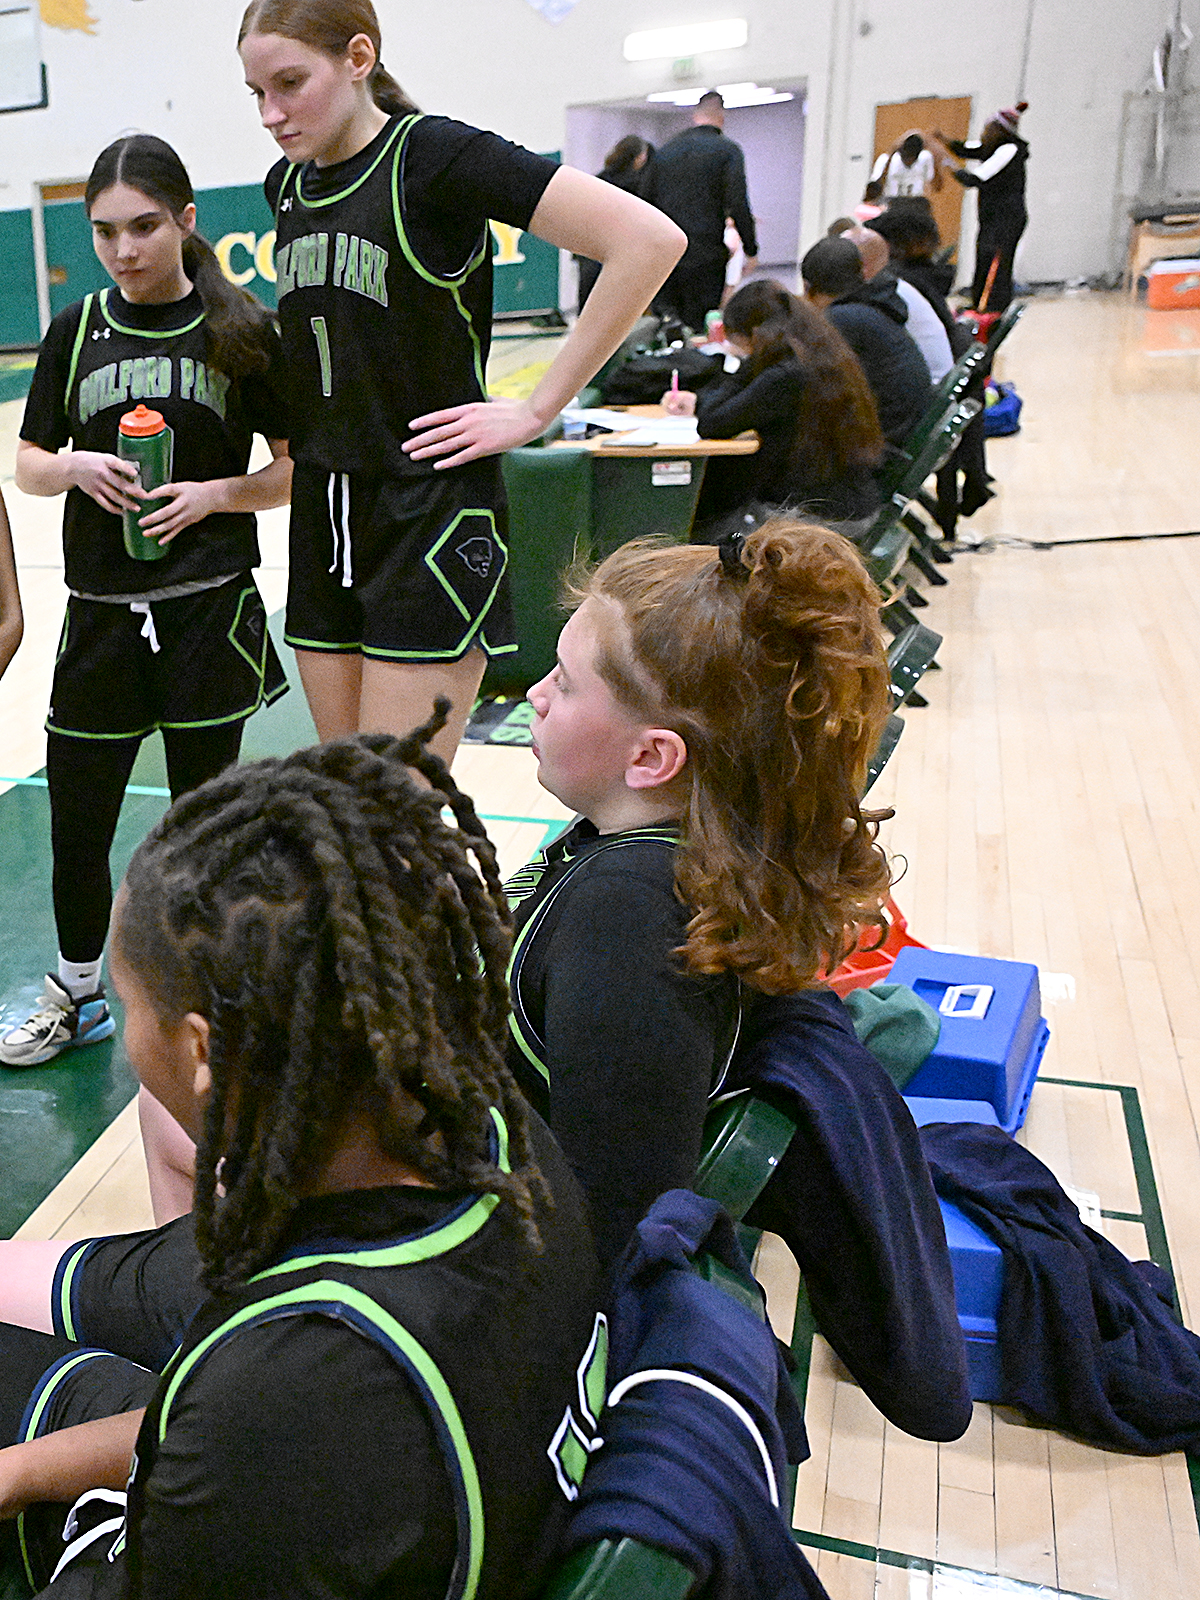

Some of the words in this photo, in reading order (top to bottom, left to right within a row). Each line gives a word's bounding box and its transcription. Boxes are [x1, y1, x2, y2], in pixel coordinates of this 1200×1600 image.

[333, 232, 389, 308] PARK
[78, 356, 173, 425] GUILFORD
[310, 316, 332, 397] 1
